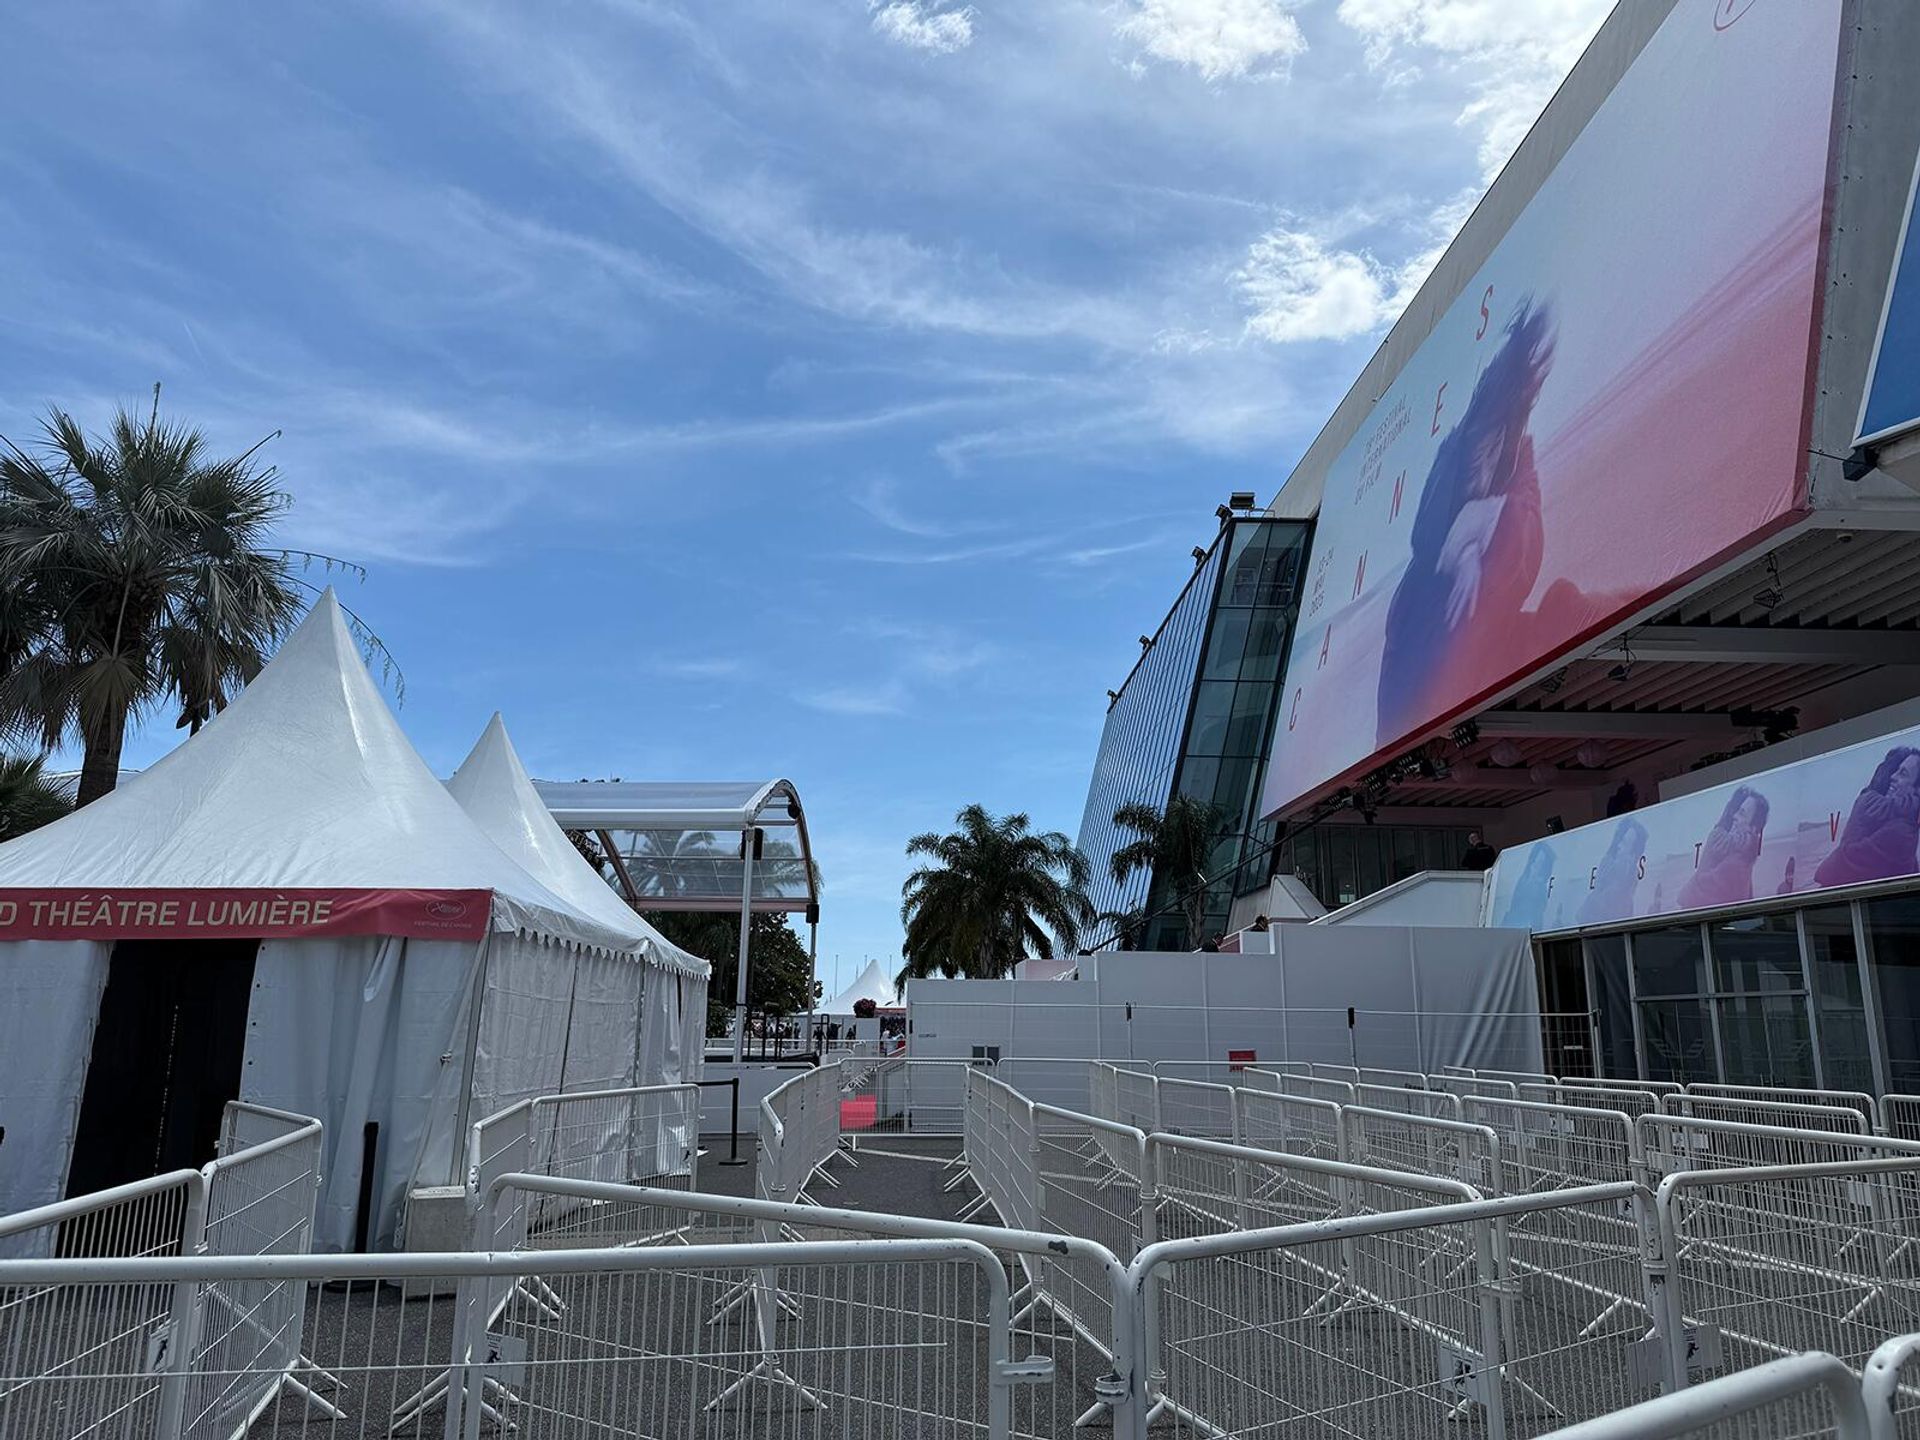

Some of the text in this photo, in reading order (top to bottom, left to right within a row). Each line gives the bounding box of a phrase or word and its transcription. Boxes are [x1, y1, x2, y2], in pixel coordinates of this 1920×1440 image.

[1289, 284, 1493, 732] CANNES
[1547, 806, 1920, 898] FESTIV
[29, 894, 178, 927] THÉÂTRE
[187, 895, 333, 927] LUMIÈRE
